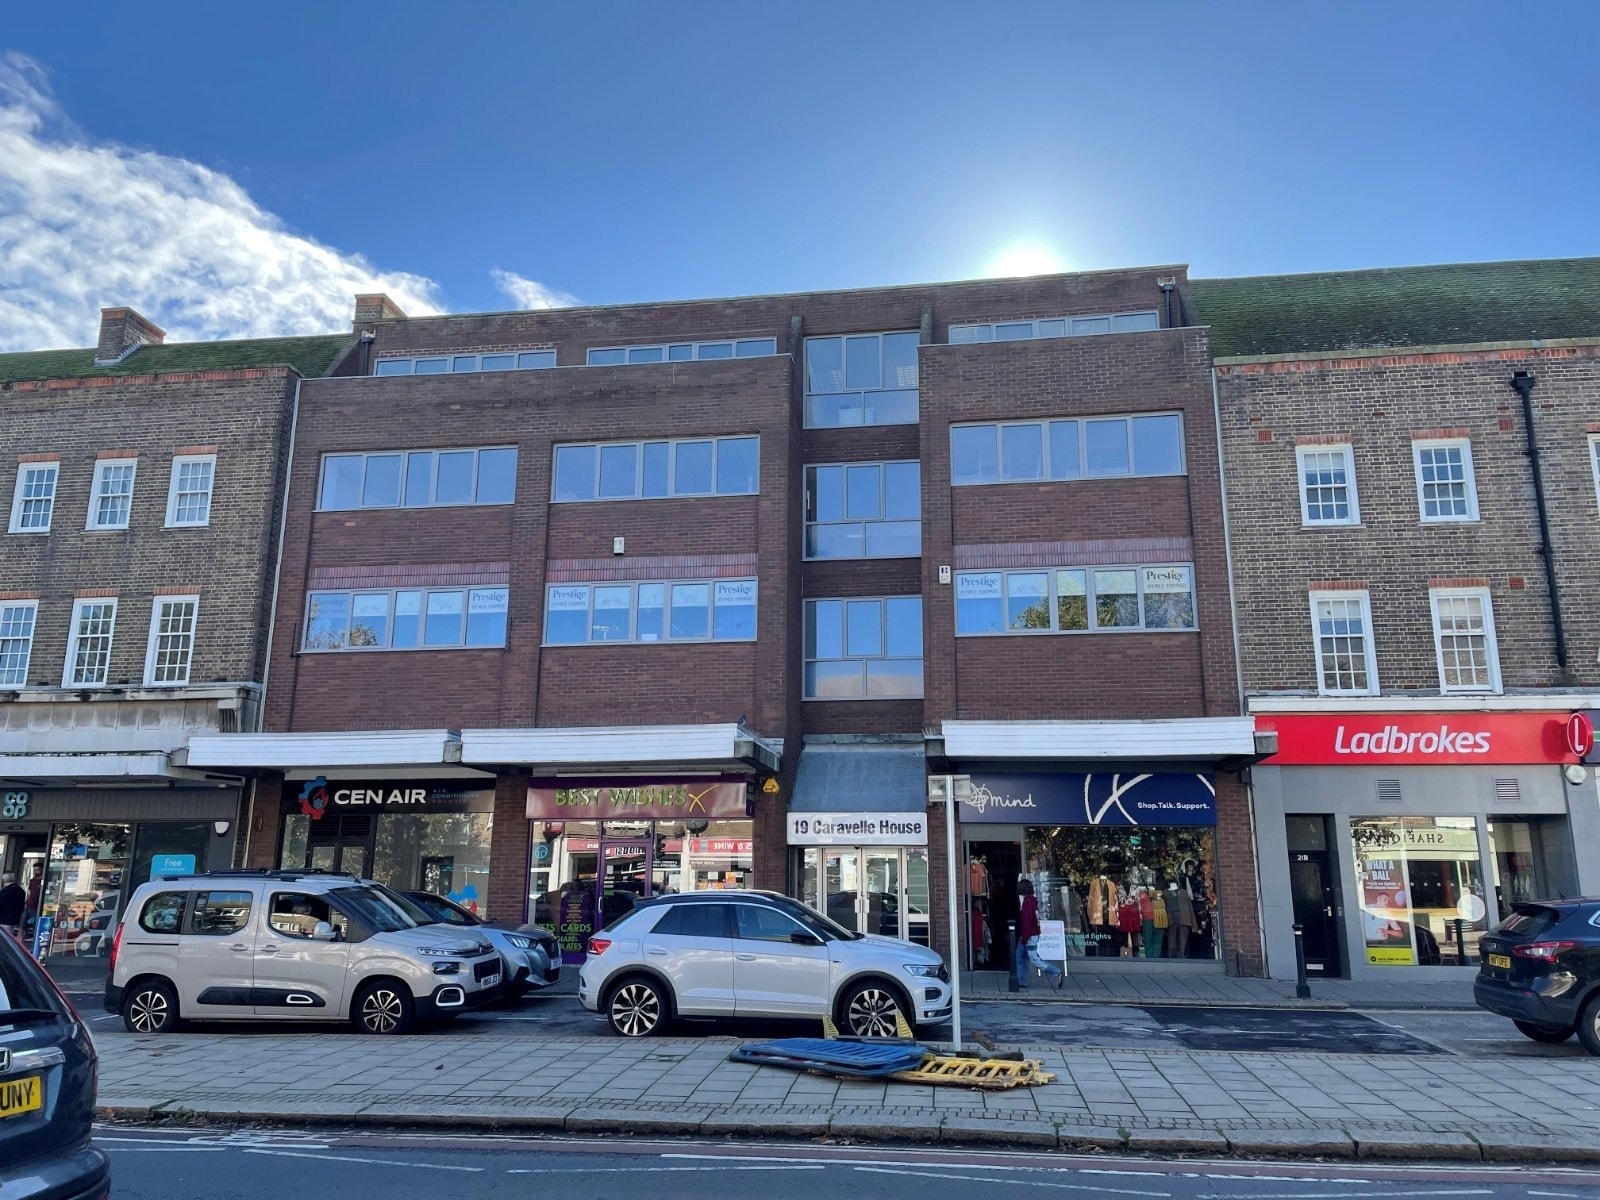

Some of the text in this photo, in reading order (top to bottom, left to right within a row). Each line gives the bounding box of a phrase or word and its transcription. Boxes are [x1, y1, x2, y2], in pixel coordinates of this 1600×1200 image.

[1146, 569, 1185, 582] Prestige
[960, 576, 998, 588] Prestige
[553, 588, 587, 600] Prestige
[718, 583, 753, 595] Prestige
[472, 591, 506, 603] Prestige
[1335, 725, 1491, 754] Ladbrokes
[1574, 718, 1584, 752] L
[334, 789, 427, 805] CEN AIR
[555, 788, 688, 807] BEST WISHES
[990, 793, 1037, 808] mind
[794, 819, 922, 835] 19 Caravelle House
[164, 858, 182, 867] Free
[1365, 860, 1395, 870] WHAT A
[1371, 870, 1391, 881] BALL
[560, 923, 592, 933] CARDS
[1091, 932, 1112, 941] fights
[0, 1080, 34, 1111] UNY
